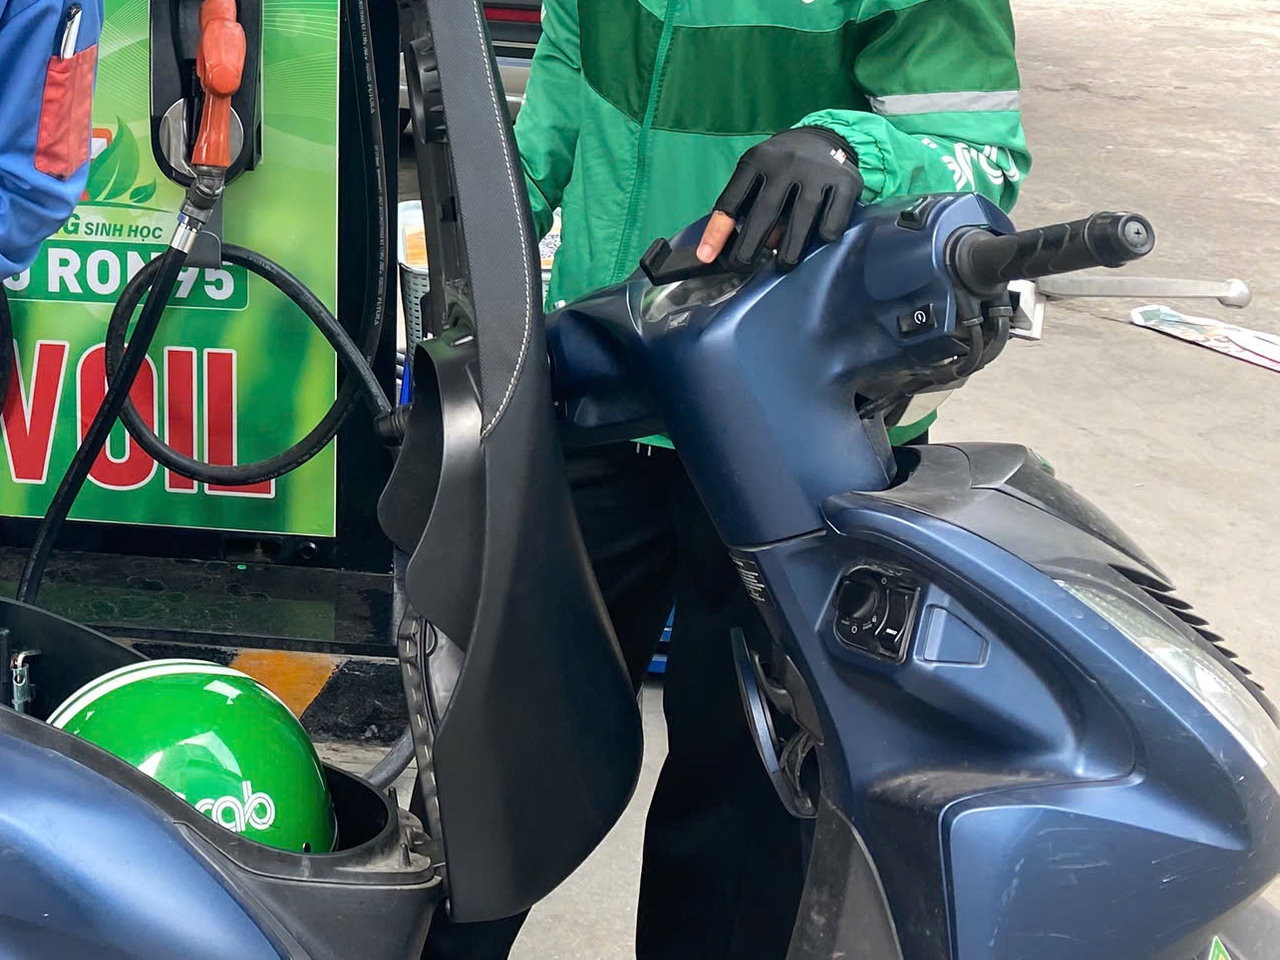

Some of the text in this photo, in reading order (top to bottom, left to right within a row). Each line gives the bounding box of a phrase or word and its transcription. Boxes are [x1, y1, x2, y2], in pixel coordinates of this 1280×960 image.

[84, 222, 121, 237] SINH
[127, 225, 163, 242] HỌC
[175, 781, 276, 833] rab
